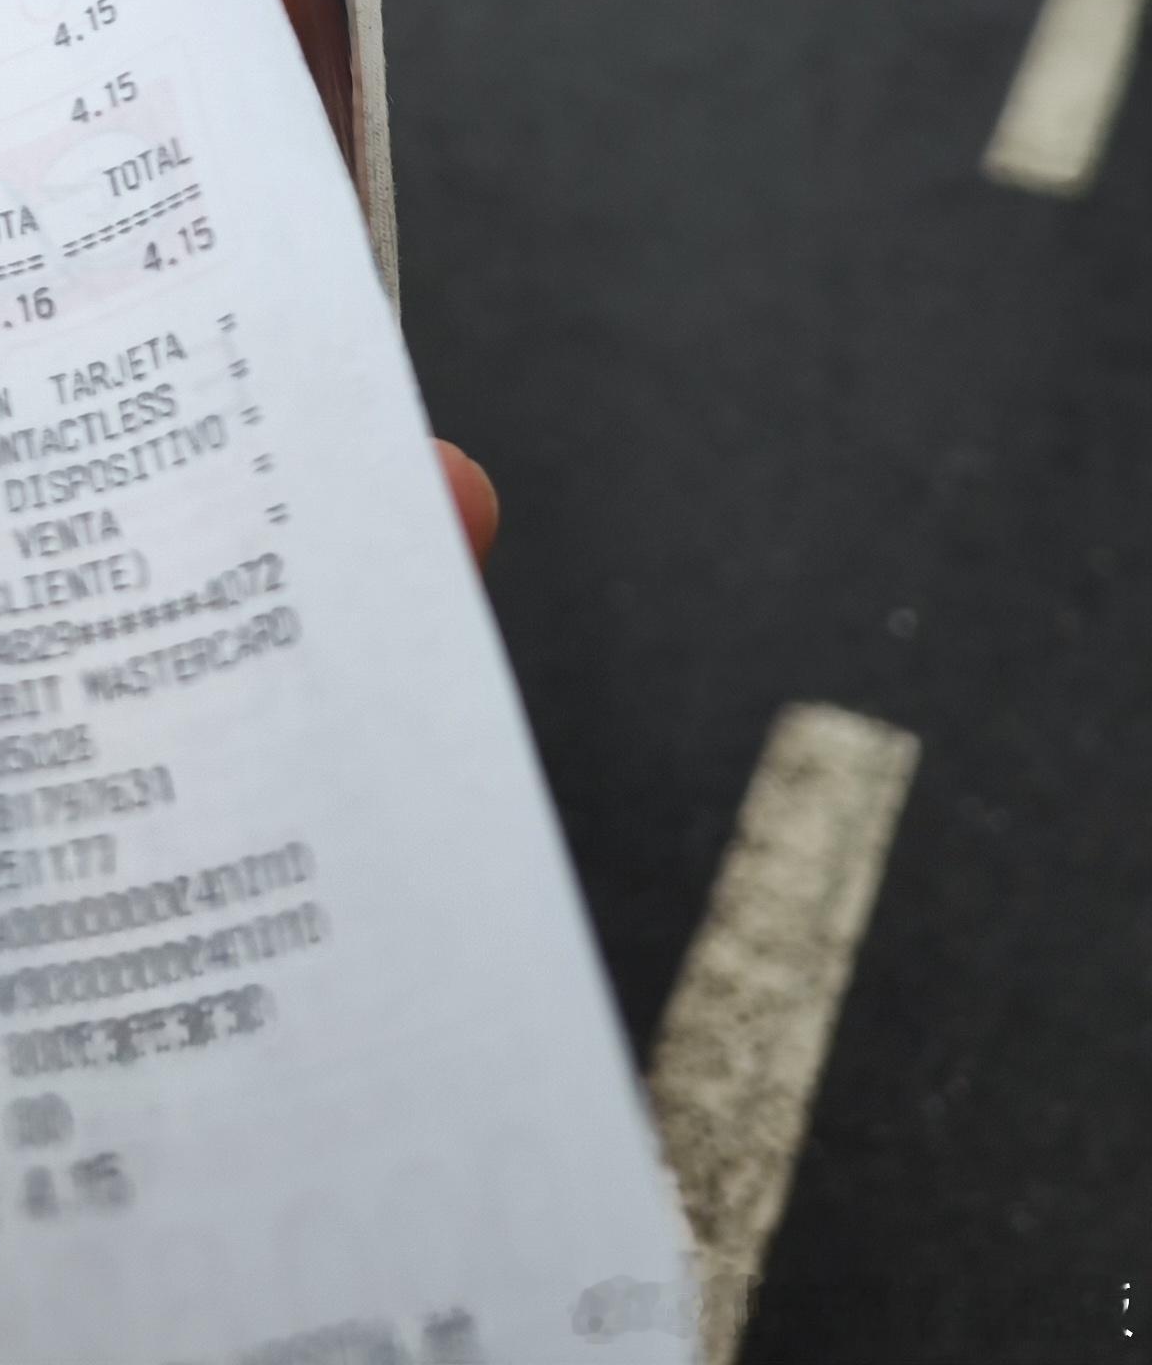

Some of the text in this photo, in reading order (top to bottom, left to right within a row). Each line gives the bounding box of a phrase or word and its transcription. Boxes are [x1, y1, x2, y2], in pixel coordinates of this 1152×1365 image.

[71, 73, 139, 125] 4.15
[102, 137, 193, 198] TOTAL
[144, 215, 217, 275] 4.15
[50, 332, 187, 405] TARJETA
[4, 413, 228, 515] DISPOSITIVO
[13, 507, 122, 562] VENTA
